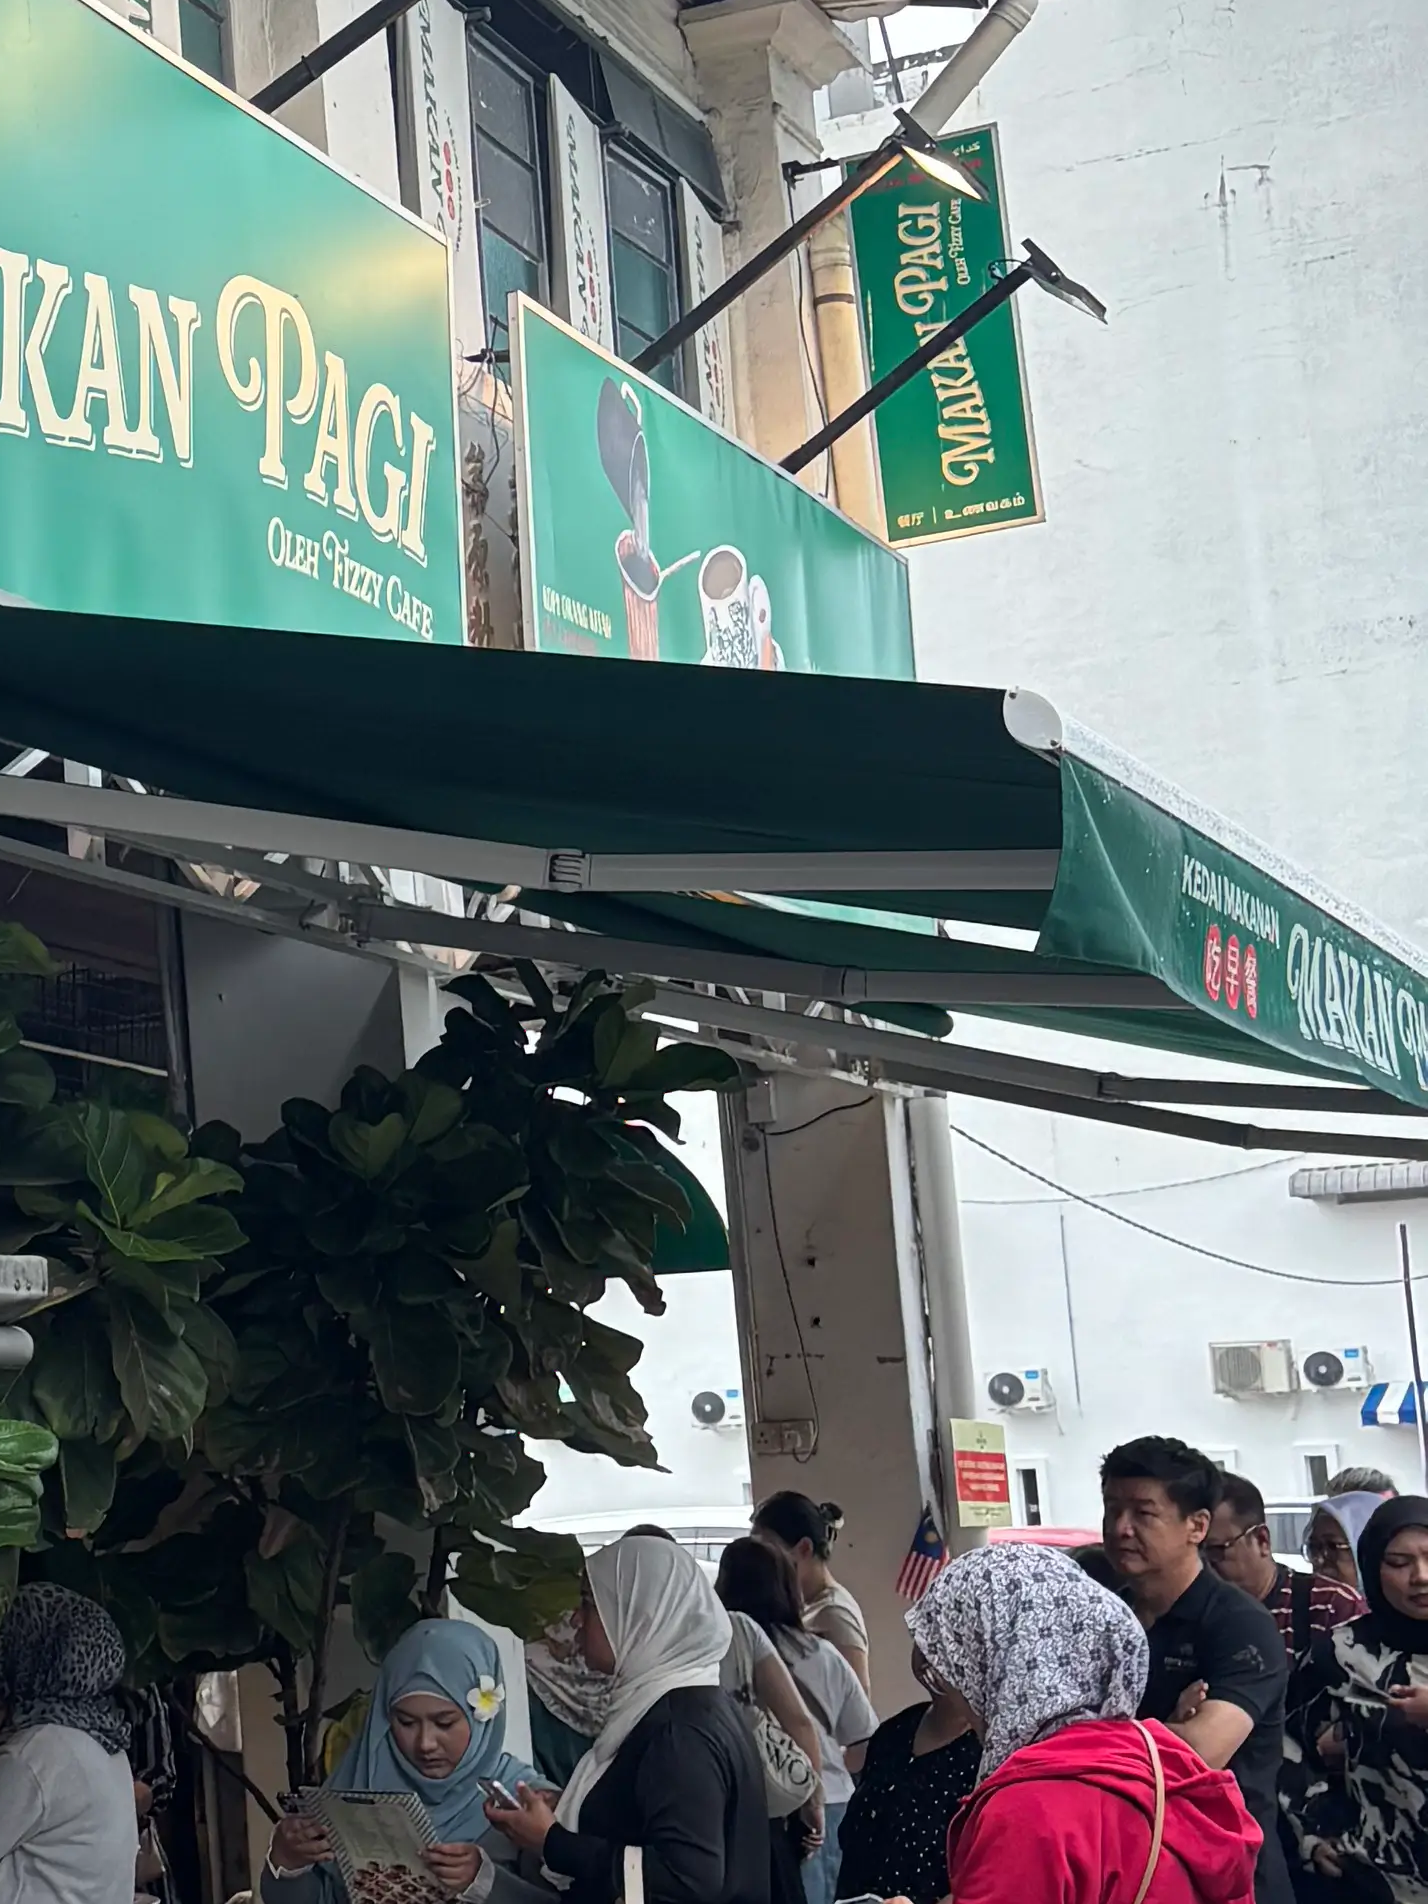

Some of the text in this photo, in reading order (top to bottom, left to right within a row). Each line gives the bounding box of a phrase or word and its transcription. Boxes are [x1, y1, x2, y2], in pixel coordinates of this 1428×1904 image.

[894, 201, 948, 316] PAGI
[217, 274, 436, 568] PAGI
[1181, 853, 1281, 951] KEDAI MAKANAN
[1286, 923, 1403, 1082] MAKAN
